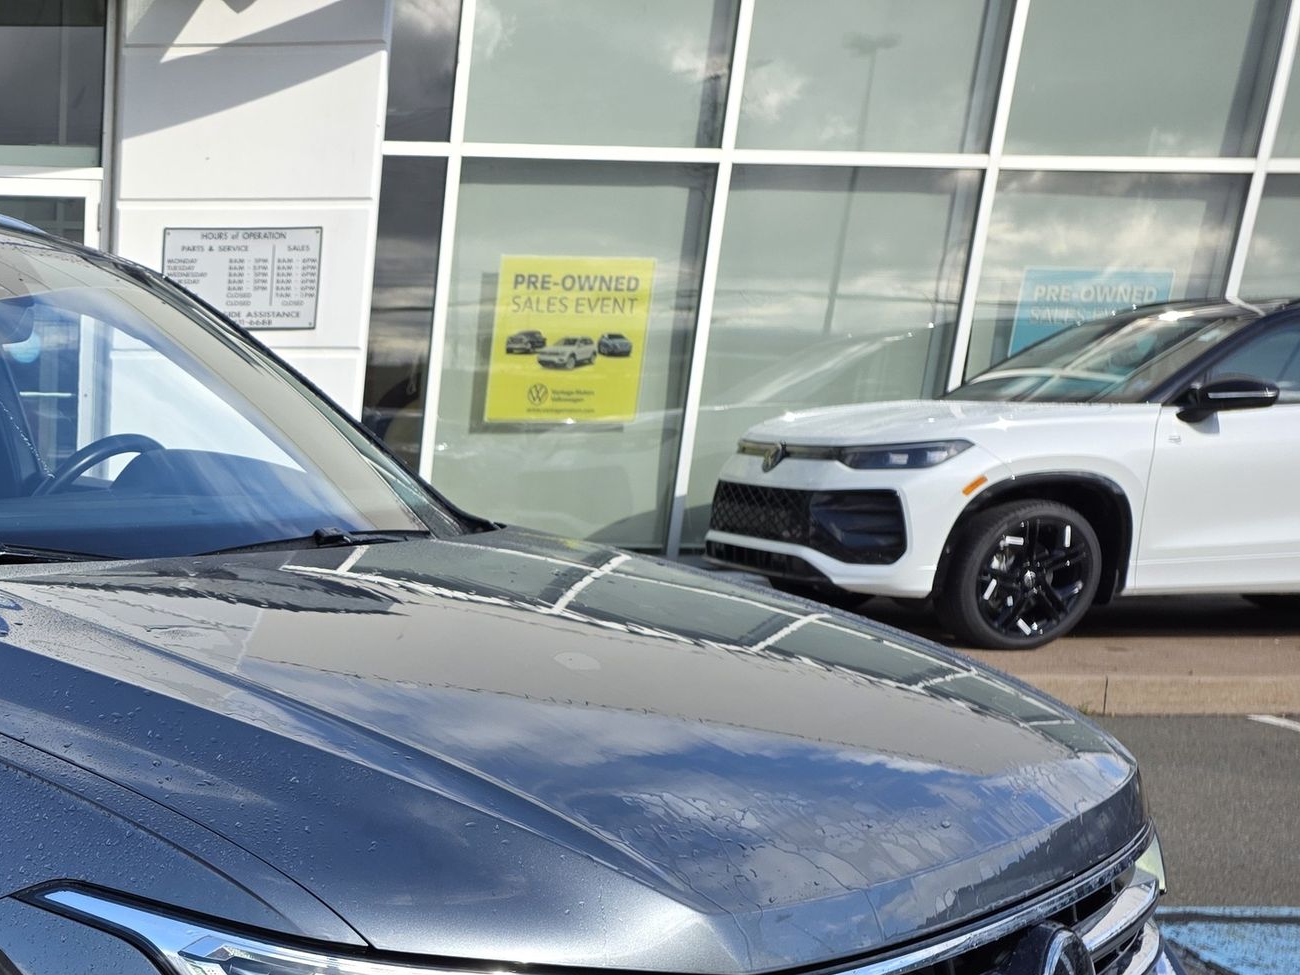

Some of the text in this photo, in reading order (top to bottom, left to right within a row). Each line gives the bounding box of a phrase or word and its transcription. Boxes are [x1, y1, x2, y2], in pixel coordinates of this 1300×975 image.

[201, 232, 229, 240] HOURS
[242, 231, 287, 240] OPERATION
[513, 274, 640, 292] PRE-OWNED
[1034, 284, 1157, 303] PRE-OWNED
[511, 295, 639, 314] SALES EVENT
